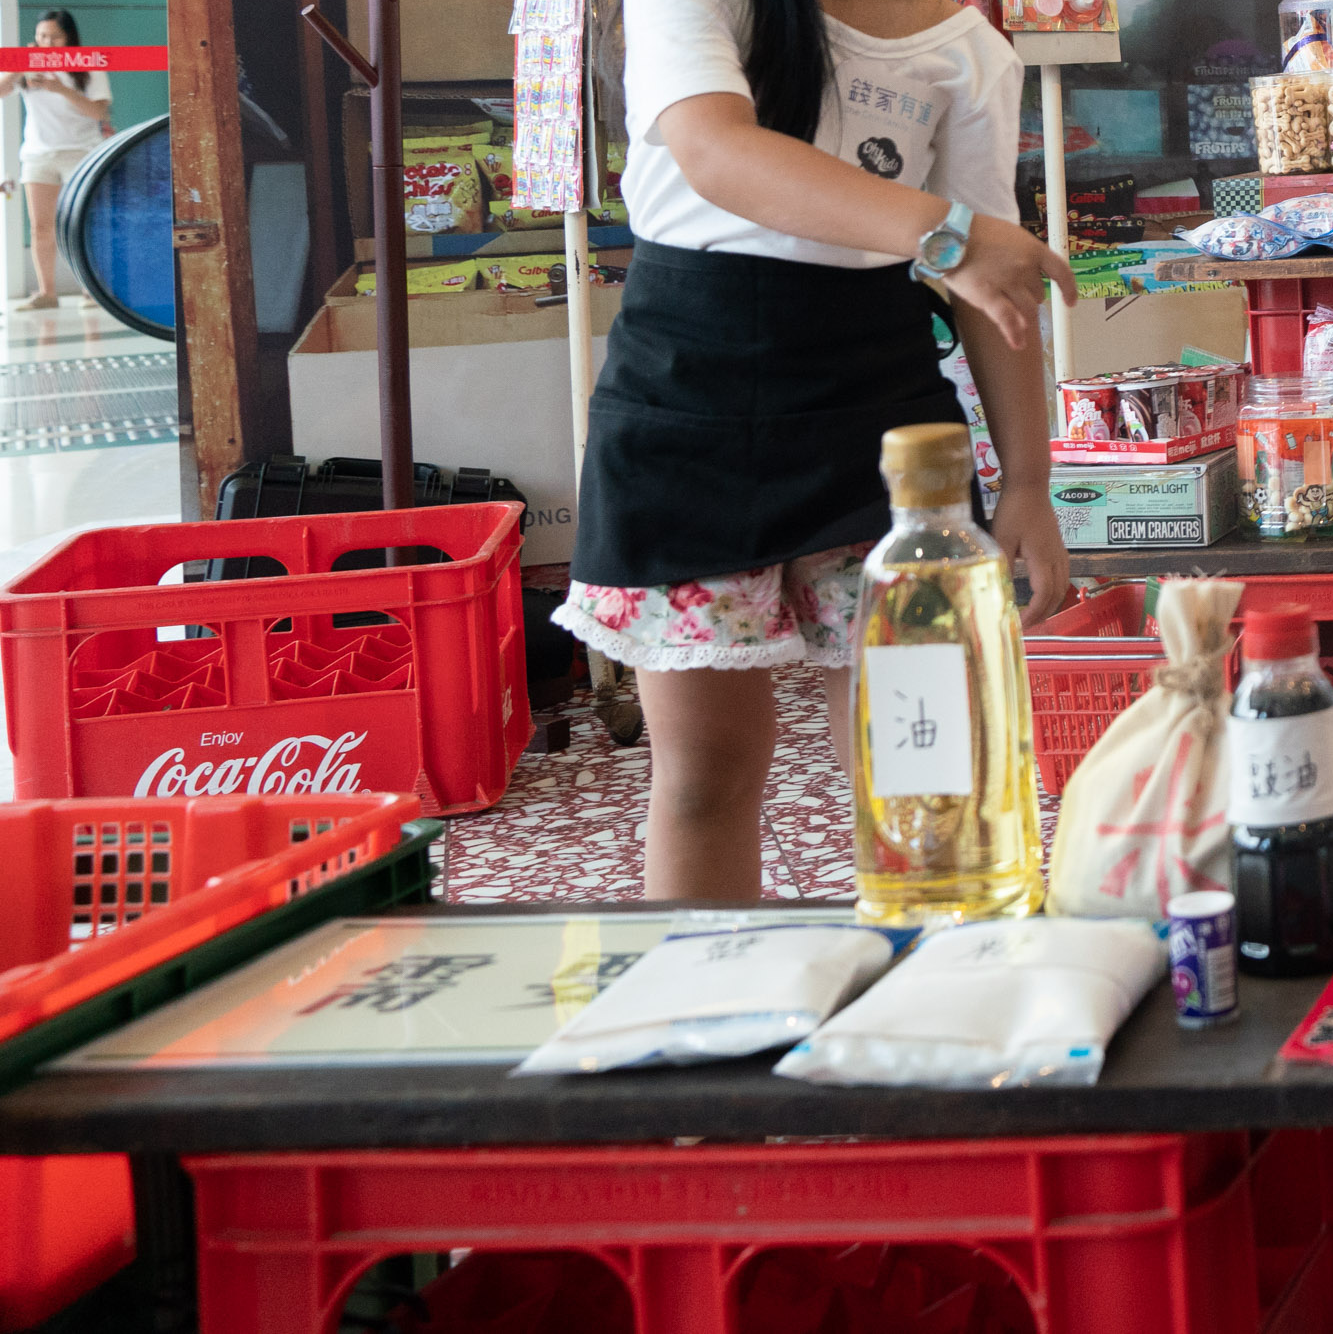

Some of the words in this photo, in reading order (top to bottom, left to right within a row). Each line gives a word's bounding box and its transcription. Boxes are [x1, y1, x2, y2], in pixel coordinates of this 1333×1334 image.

[28, 51, 63, 69] 置富
[64, 50, 108, 70] Malls
[848, 77, 934, 127] 錢家有道
[403, 162, 462, 180] otato
[518, 266, 550, 276] Calbe
[1178, 440, 1198, 456] meiji
[1060, 491, 1098, 501] JACOB'S
[1129, 483, 1160, 495] EXTRA
[1162, 483, 1190, 495] LIGHT
[1110, 521, 1146, 540] CREAM
[1148, 518, 1201, 539] CRACKERS
[894, 688, 938, 751] 油
[200, 730, 244, 748] Enjoy
[132, 730, 369, 799] Coca-Cola
[1246, 754, 1318, 800] 豉油
